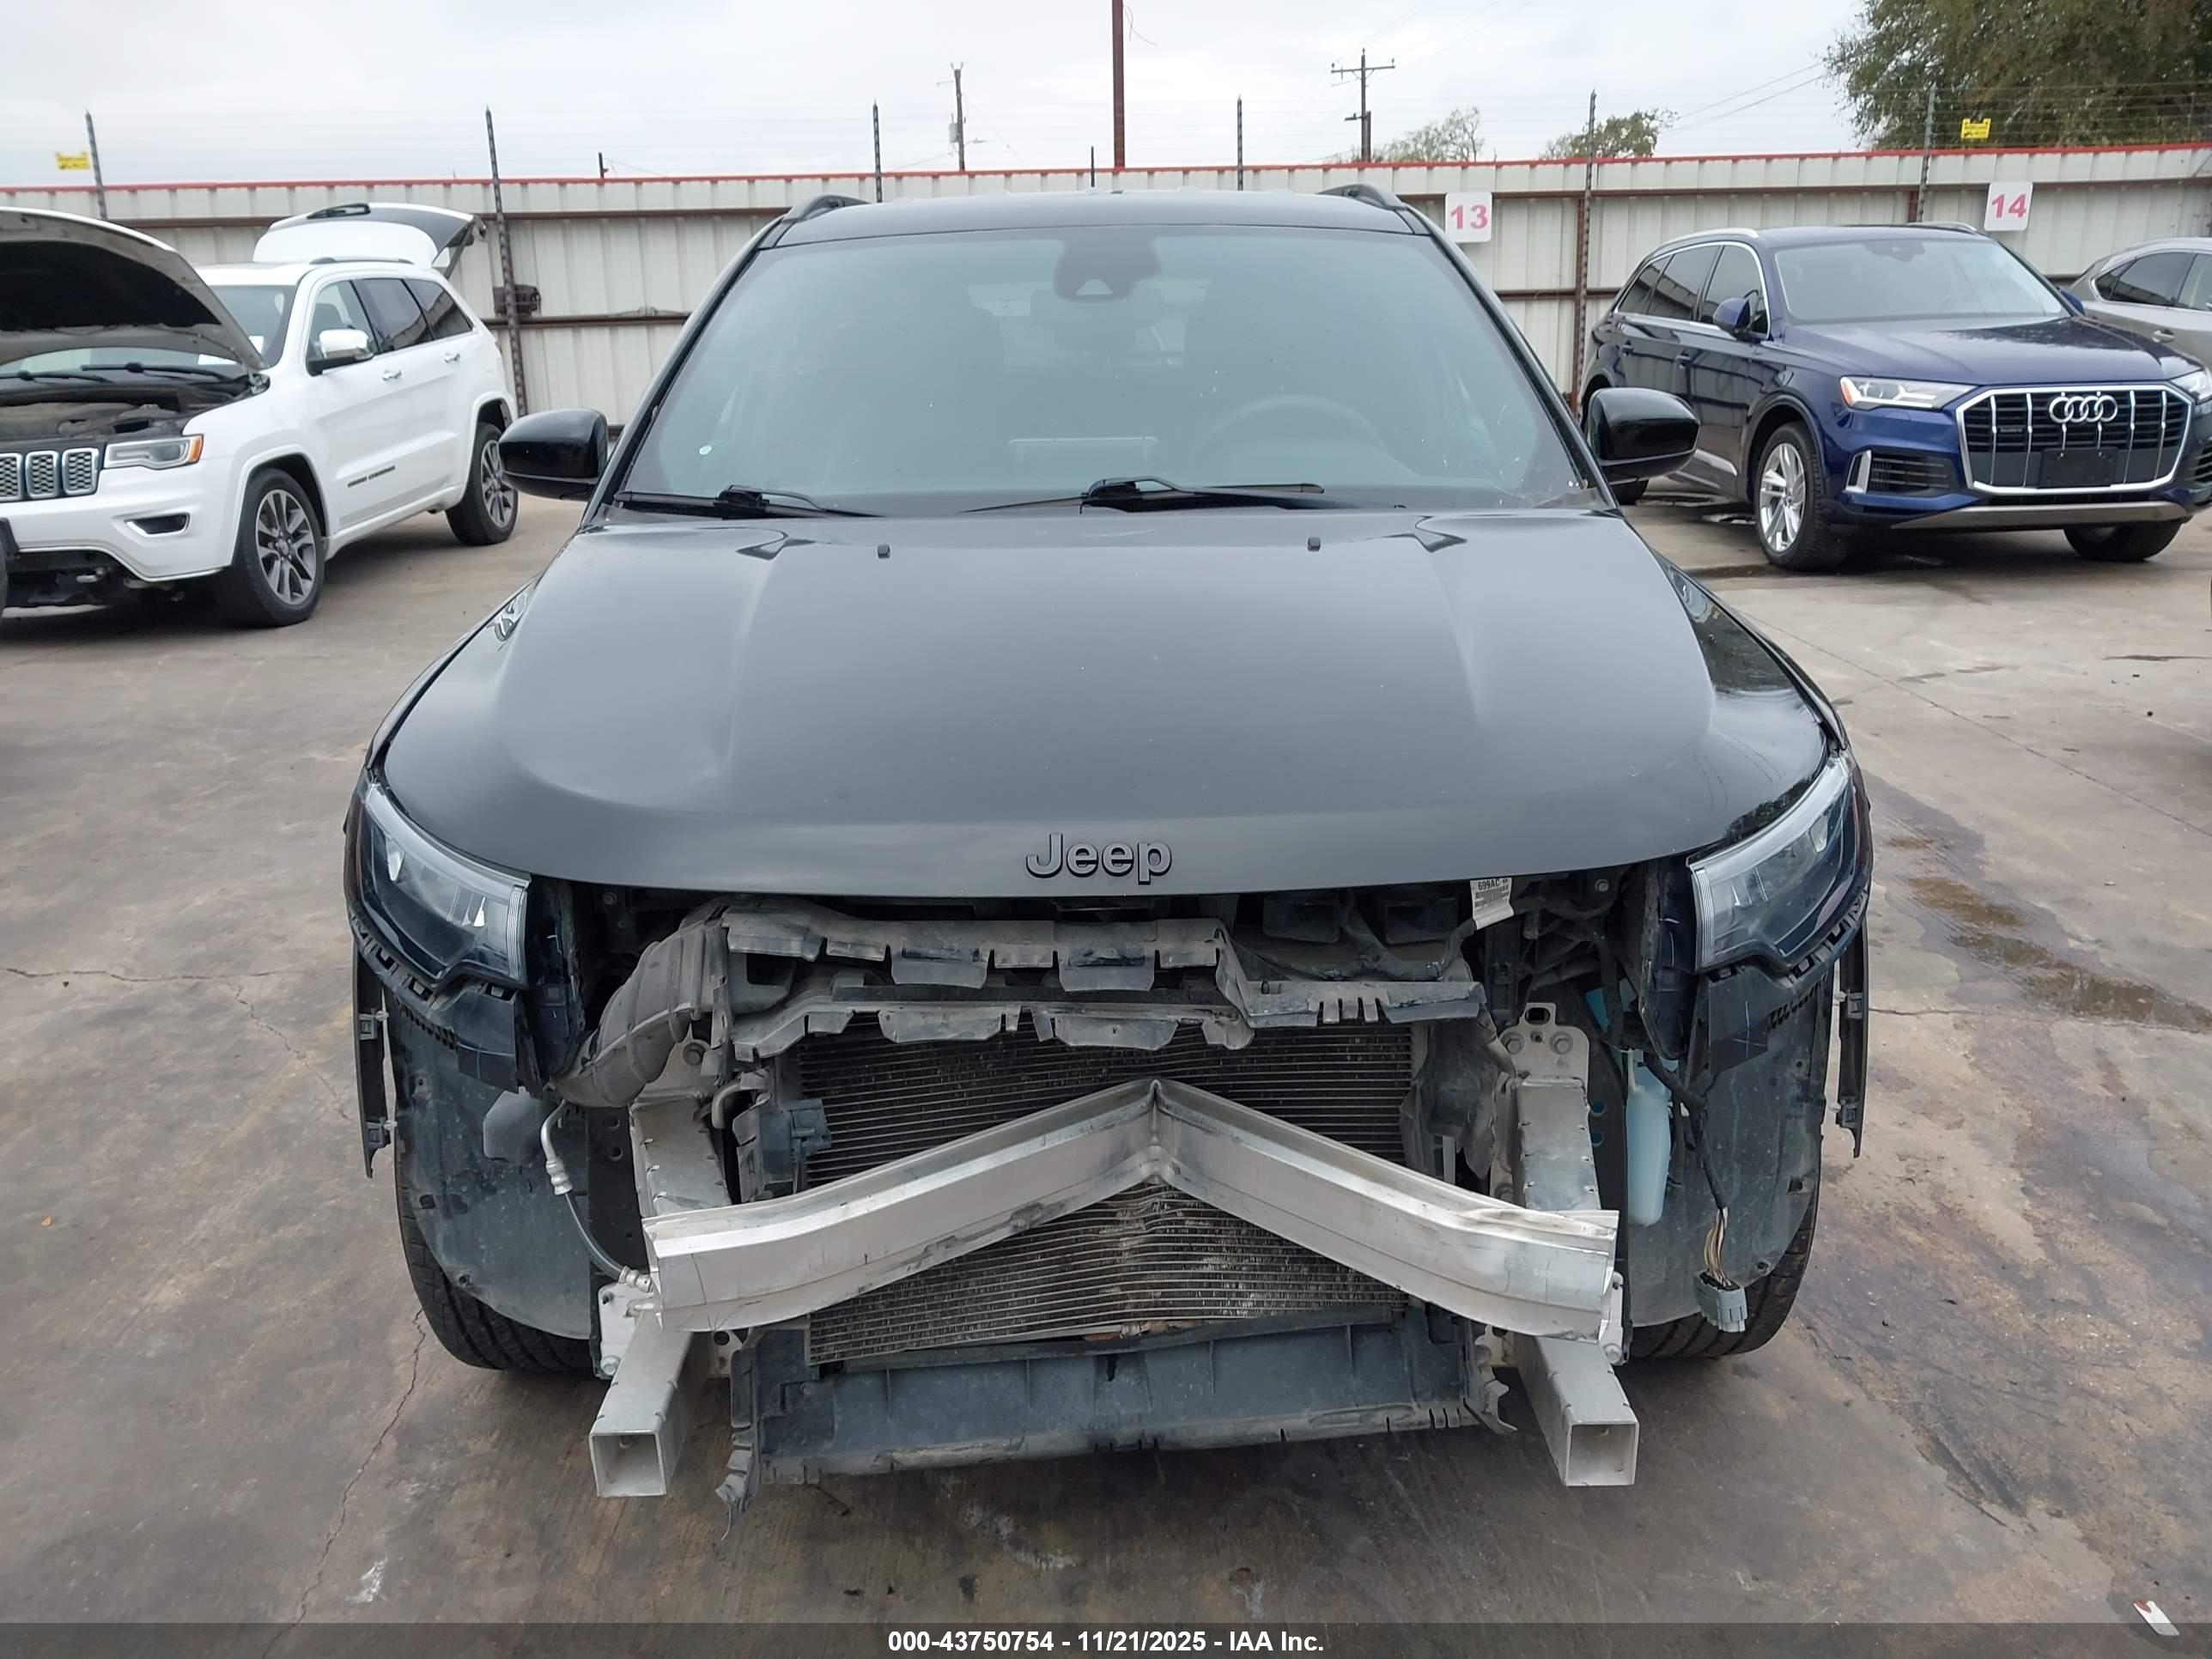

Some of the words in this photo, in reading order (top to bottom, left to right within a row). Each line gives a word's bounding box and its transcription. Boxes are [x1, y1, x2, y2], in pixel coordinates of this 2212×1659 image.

[1450, 204, 1488, 230] 13
[1992, 194, 2027, 218] 14
[1026, 833, 1172, 885] Jeep
